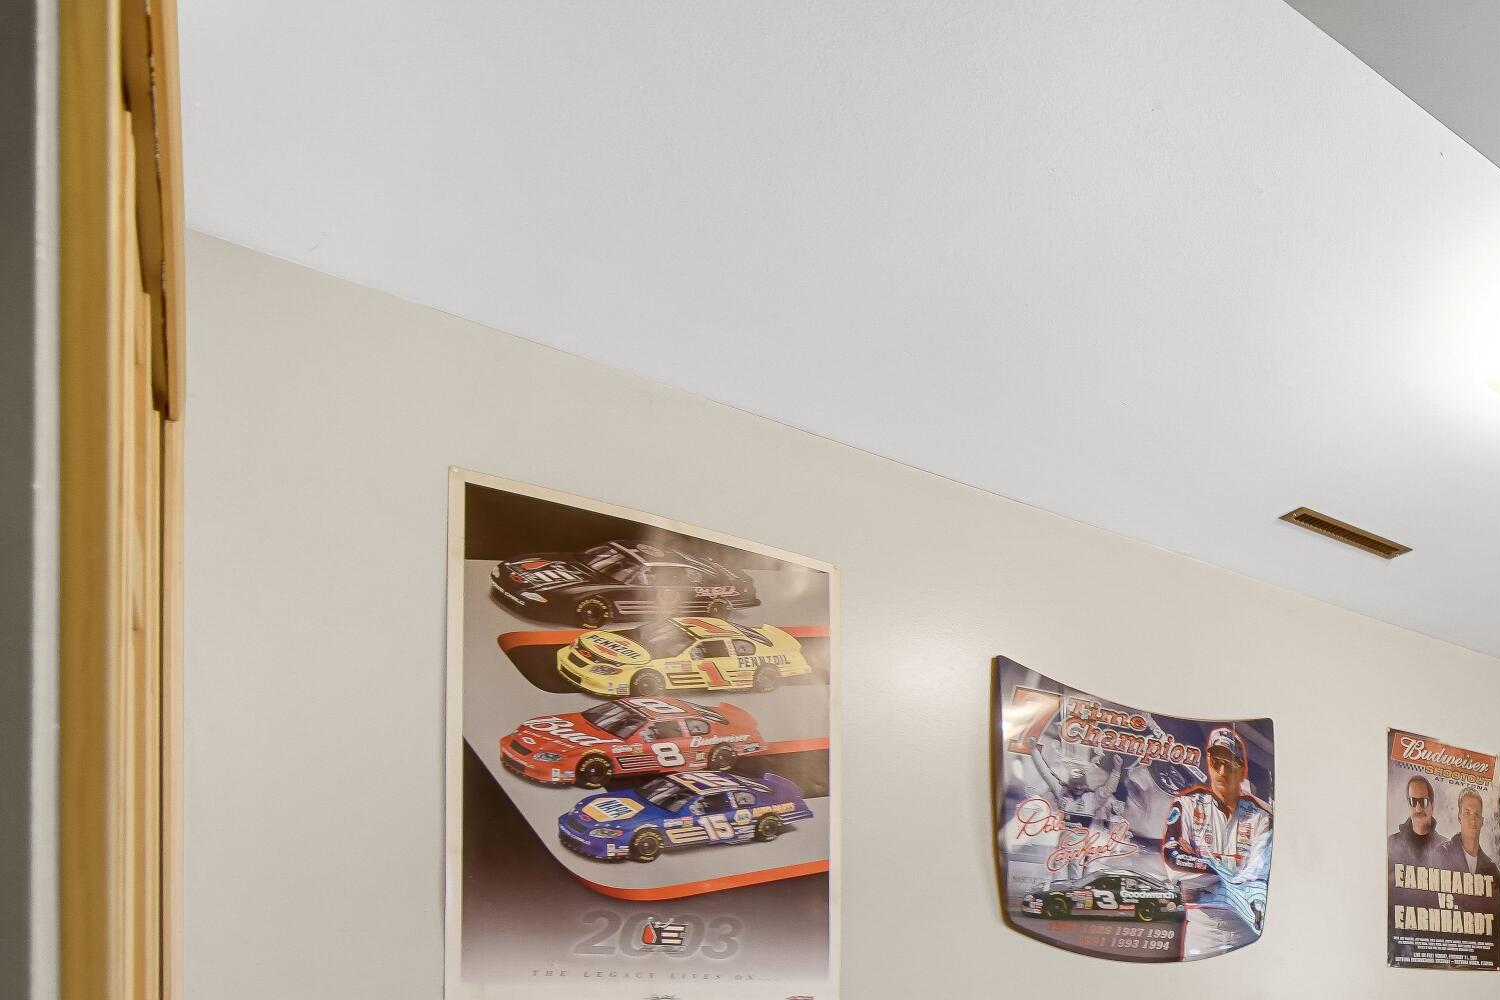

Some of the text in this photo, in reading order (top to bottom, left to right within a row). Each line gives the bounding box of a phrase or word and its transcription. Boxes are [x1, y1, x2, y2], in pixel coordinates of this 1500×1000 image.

[586, 634, 642, 660] PENNZOIL
[521, 716, 624, 747] Bud
[1008, 686, 1149, 756] 7 Time
[650, 742, 686, 768] 8
[1061, 716, 1202, 767] Champion
[1400, 737, 1489, 773] Budweiser
[1424, 765, 1492, 787] SHOOTOUT
[698, 814, 735, 841] 15
[1394, 863, 1494, 898] EARNHARDT
[1093, 889, 1119, 910] 3
[1115, 926, 1145, 938] 1987
[1147, 928, 1175, 940] 1990
[1394, 904, 1495, 936] EARNHARDT
[1111, 937, 1140, 949] 1993
[1142, 940, 1170, 951] 1994
